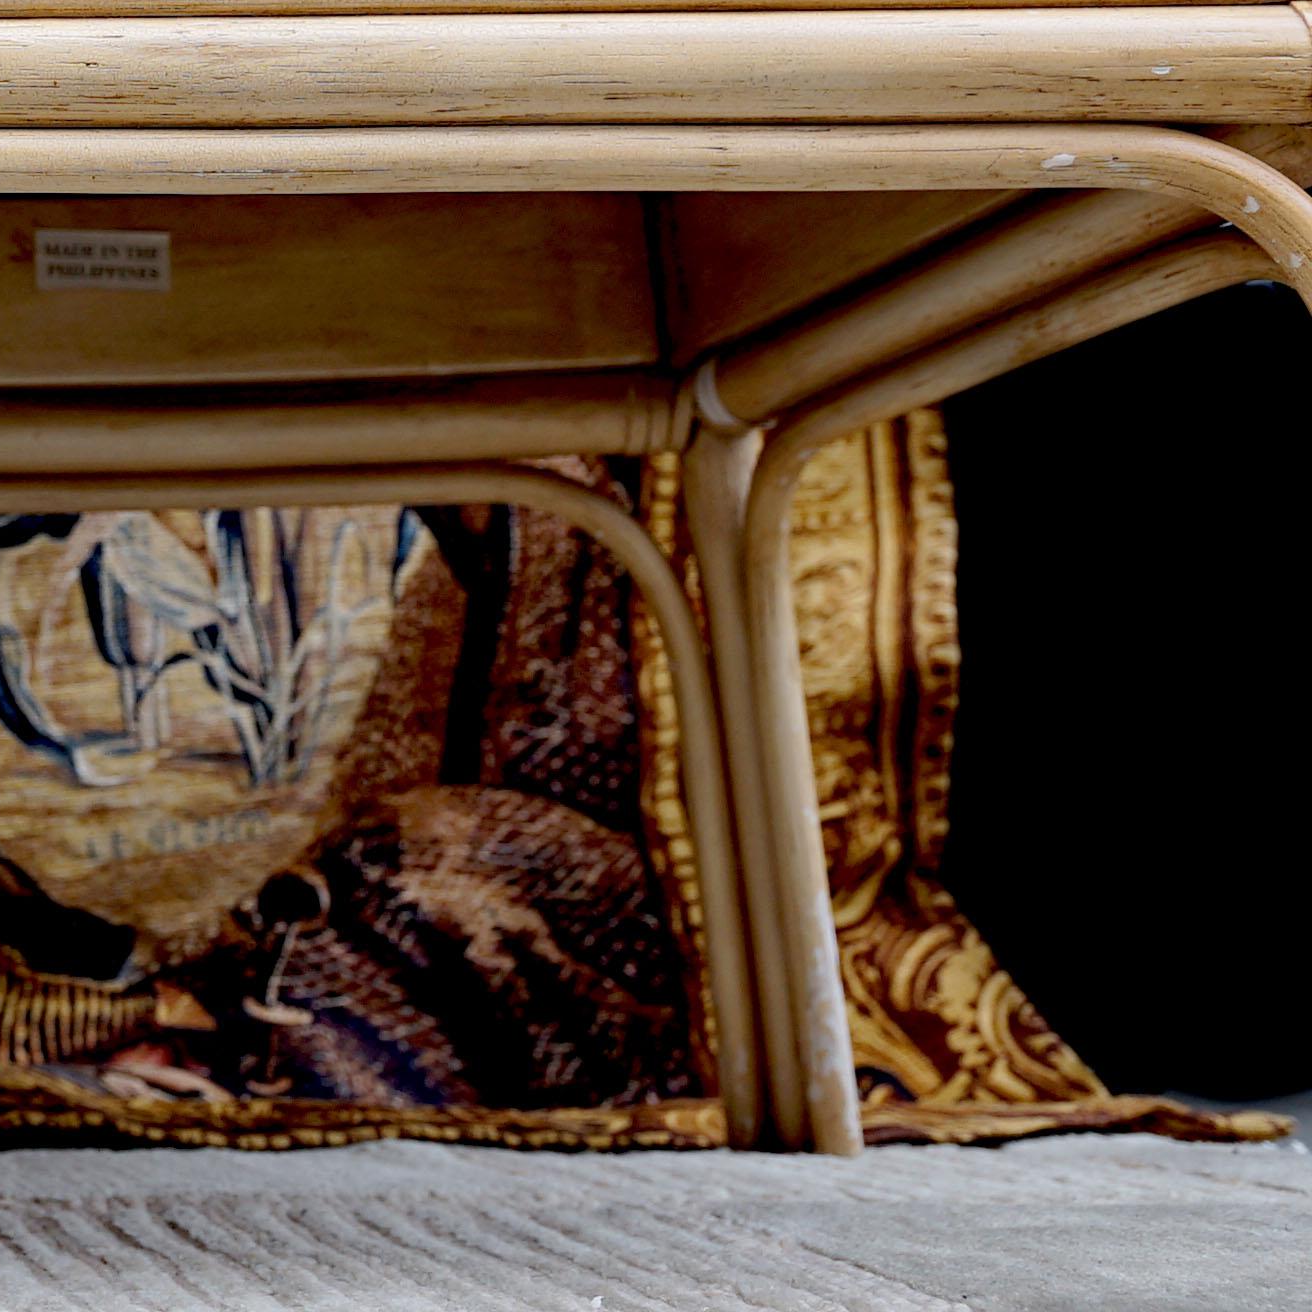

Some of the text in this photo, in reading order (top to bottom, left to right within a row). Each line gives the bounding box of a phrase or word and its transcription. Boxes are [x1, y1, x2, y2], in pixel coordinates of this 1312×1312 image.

[44, 243, 158, 259] MADE IN THE
[47, 263, 160, 279] PHILIPPINES
